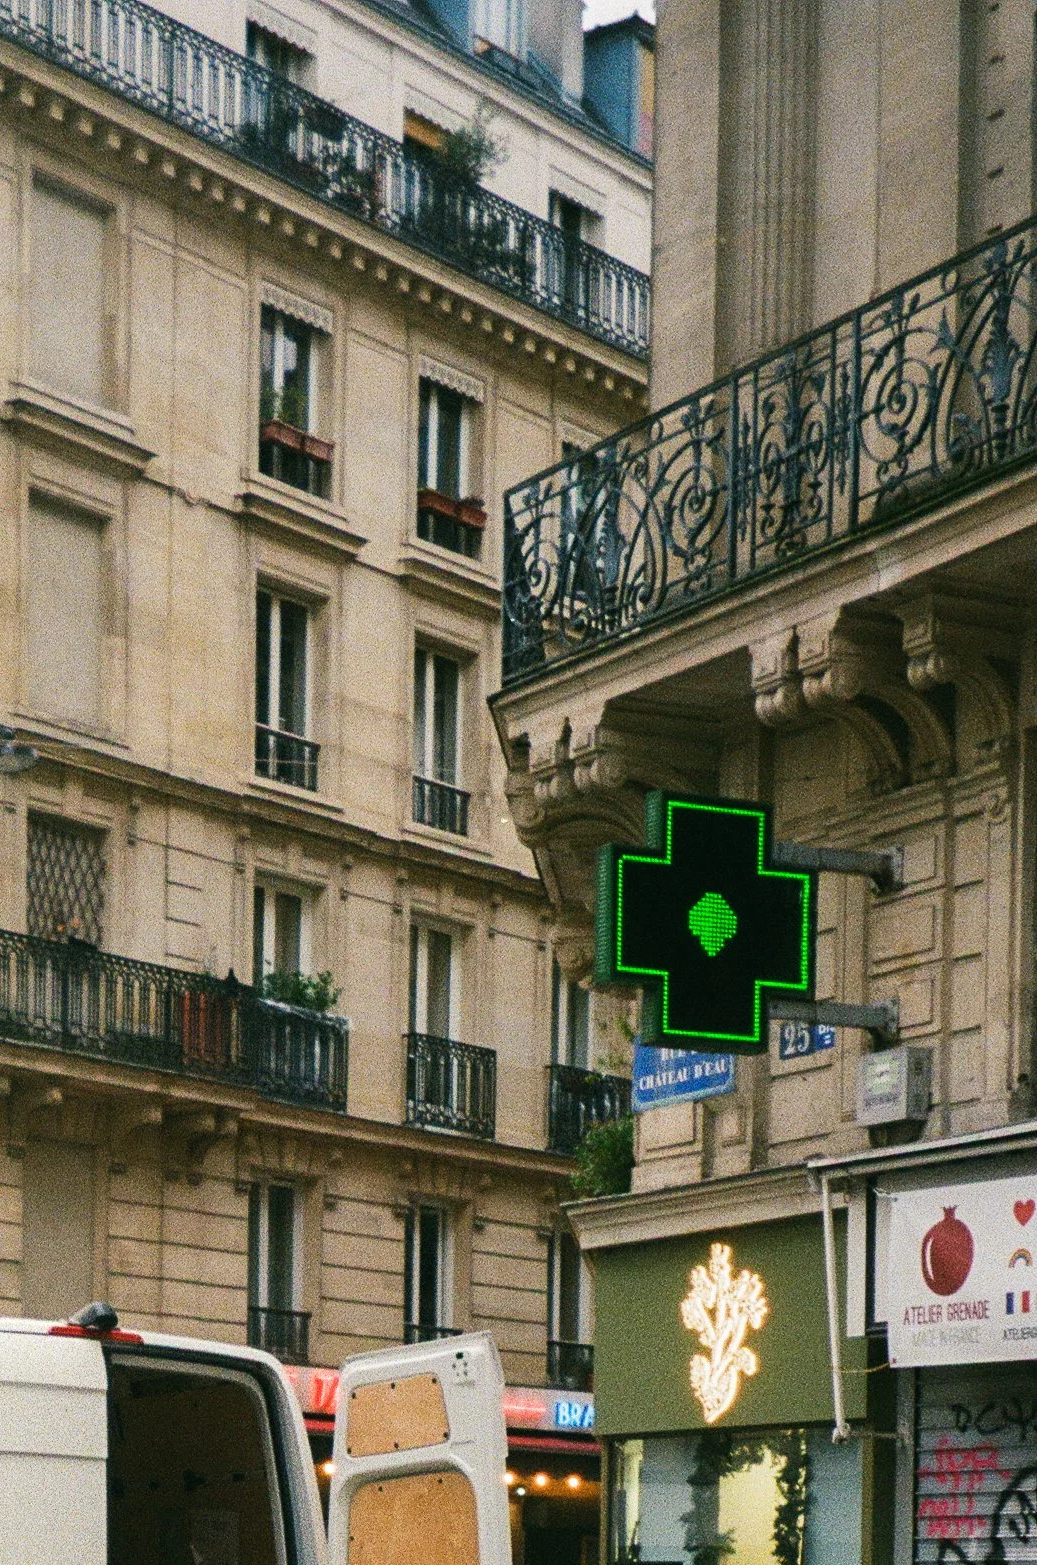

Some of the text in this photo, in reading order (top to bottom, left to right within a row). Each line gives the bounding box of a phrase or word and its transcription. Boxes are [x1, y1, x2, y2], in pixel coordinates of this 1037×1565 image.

[783, 1020, 810, 1055] 25
[694, 1058, 727, 1078] D'EAU
[903, 1299, 990, 1325] ATELIER GRENADE
